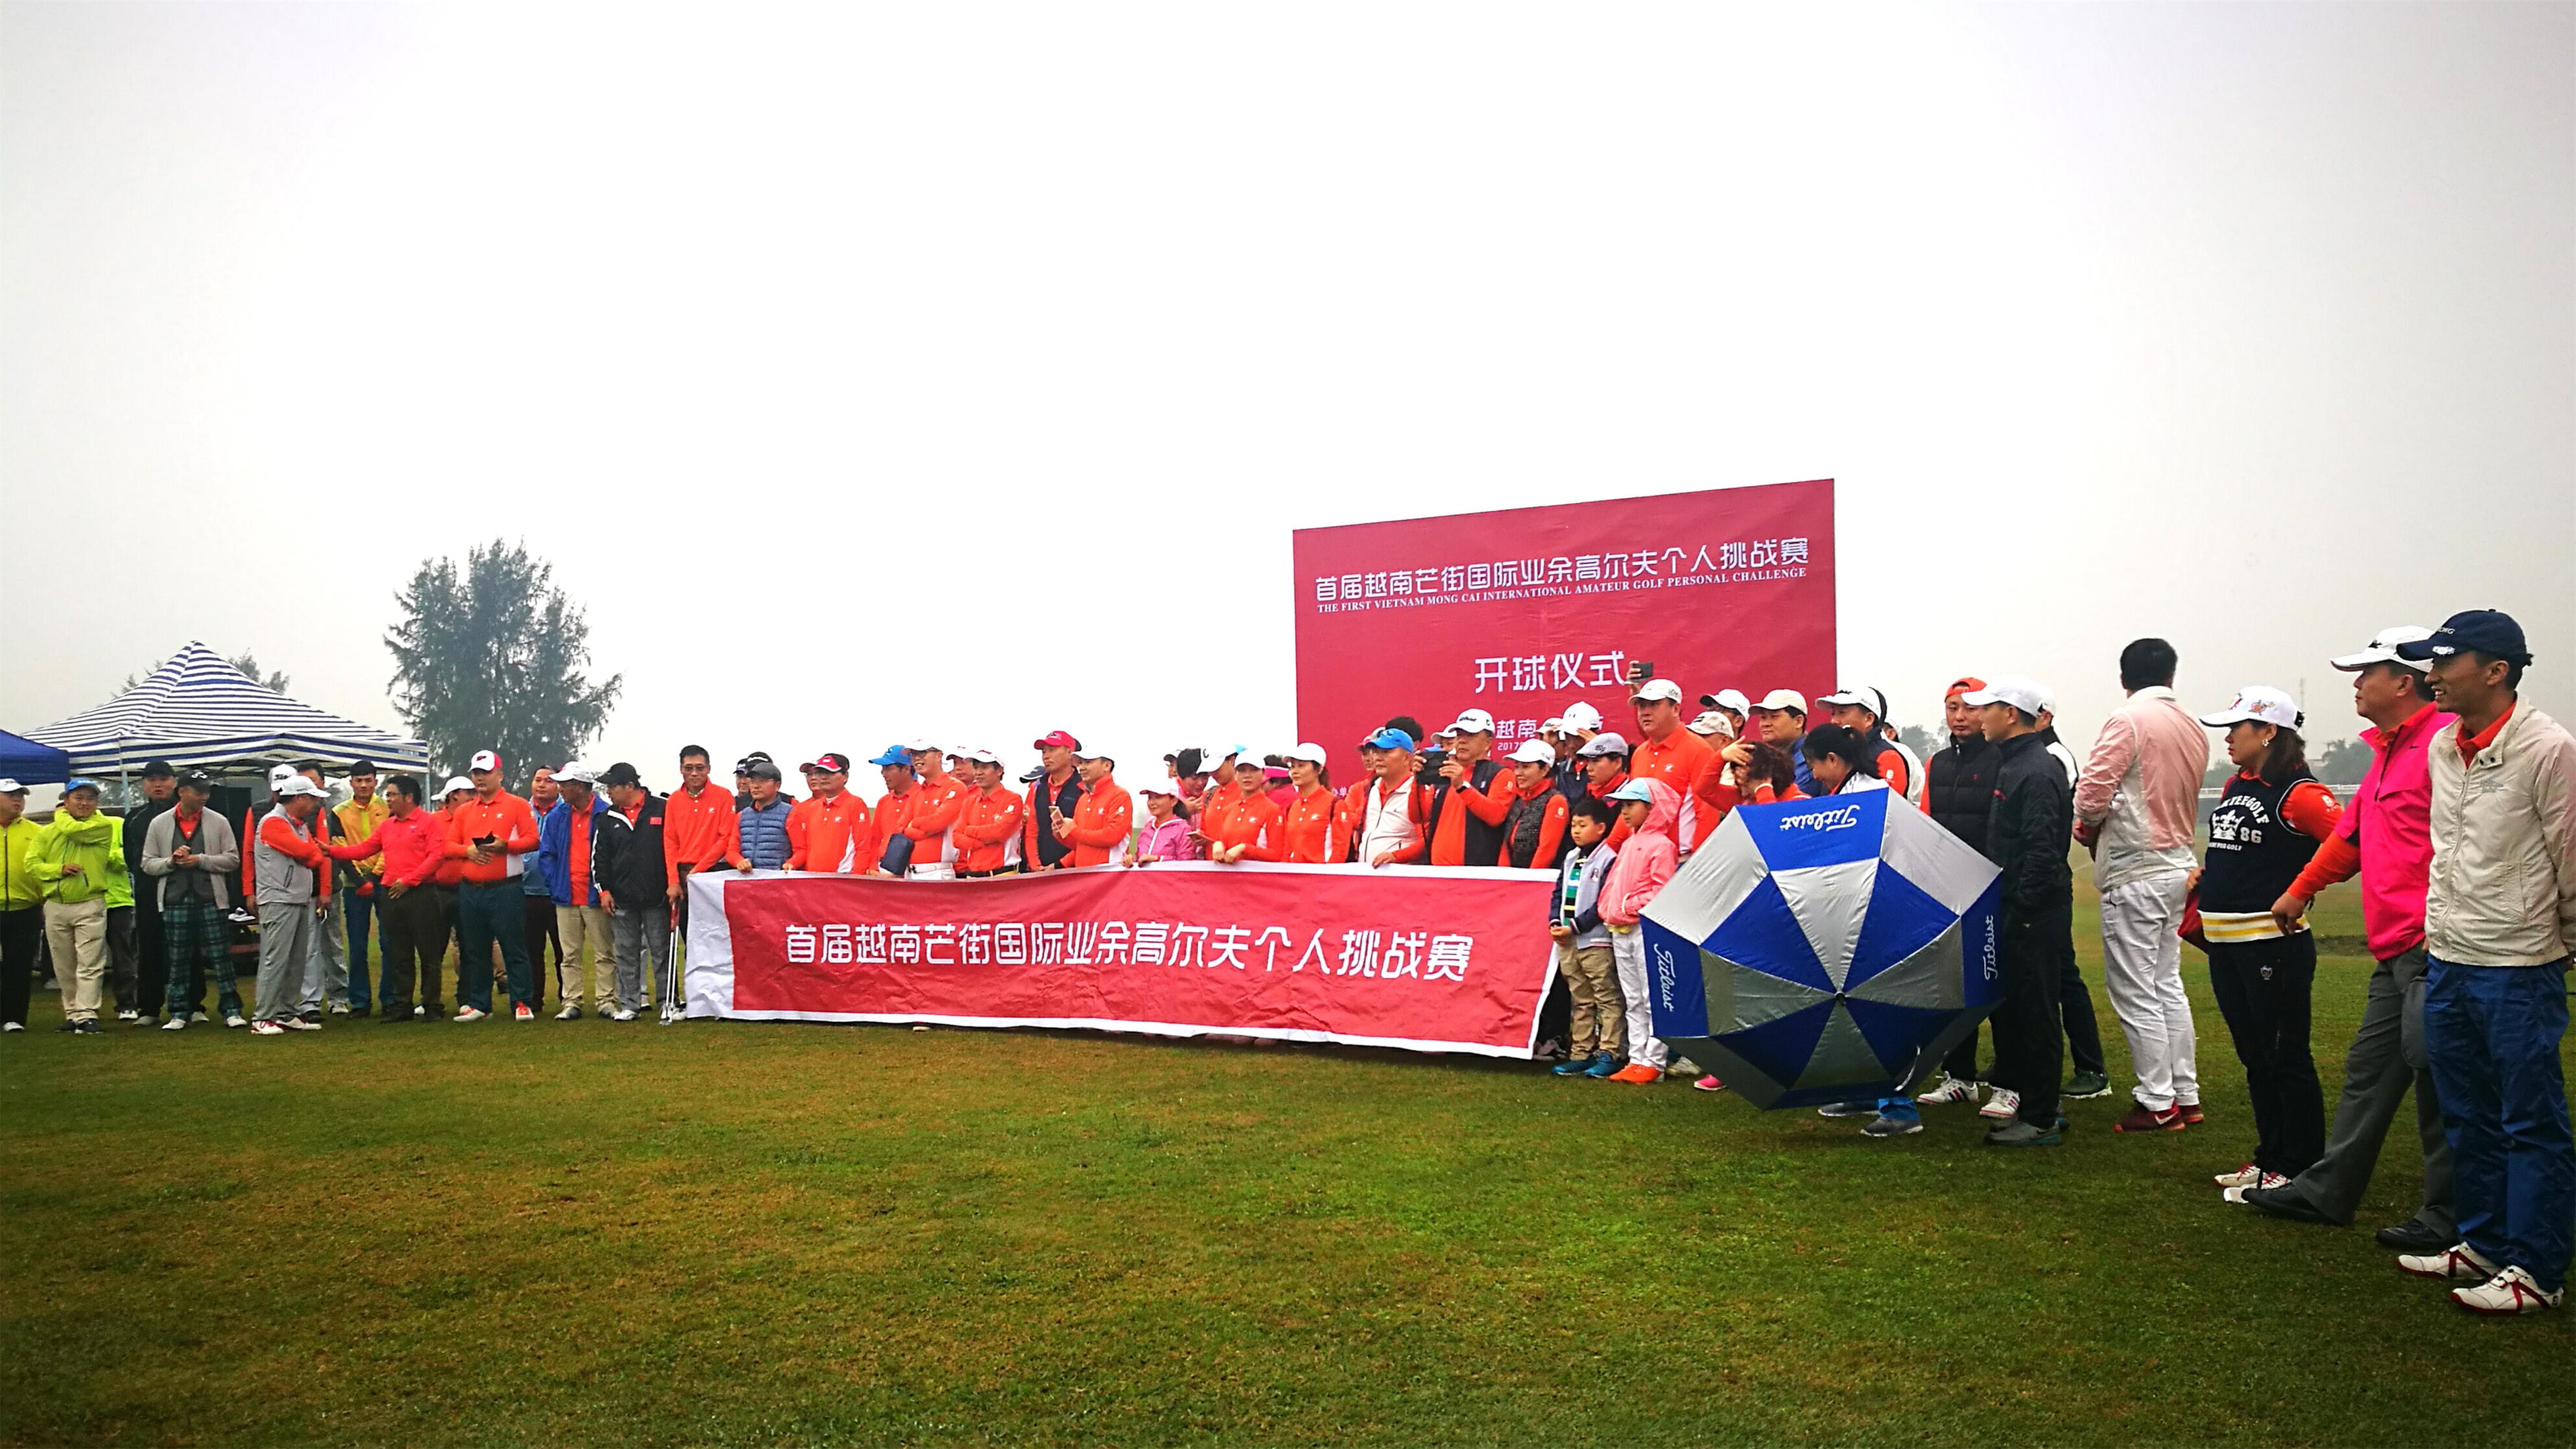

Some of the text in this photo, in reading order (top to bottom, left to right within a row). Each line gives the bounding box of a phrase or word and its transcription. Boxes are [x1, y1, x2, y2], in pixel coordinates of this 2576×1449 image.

[1314, 537, 1809, 601] 首届越南芒街国际业余高尔夫个人挑战赛
[1317, 567, 1807, 613] THE FIRST VIETNAM MONG CAI INTERNATIONAL AMATEUR GOLF PERSONAL CHALLENGE
[1475, 651, 1624, 693] 开球仪式
[1497, 742, 1523, 751] 2017
[1779, 804, 1861, 832] Titleist
[2240, 827, 2262, 844] 86
[785, 922, 1474, 982] 首届越南芒街国际业余高尔夫个人挑战赛
[1982, 914, 1998, 980] Titleist
[1653, 943, 1676, 1012] Titleist
